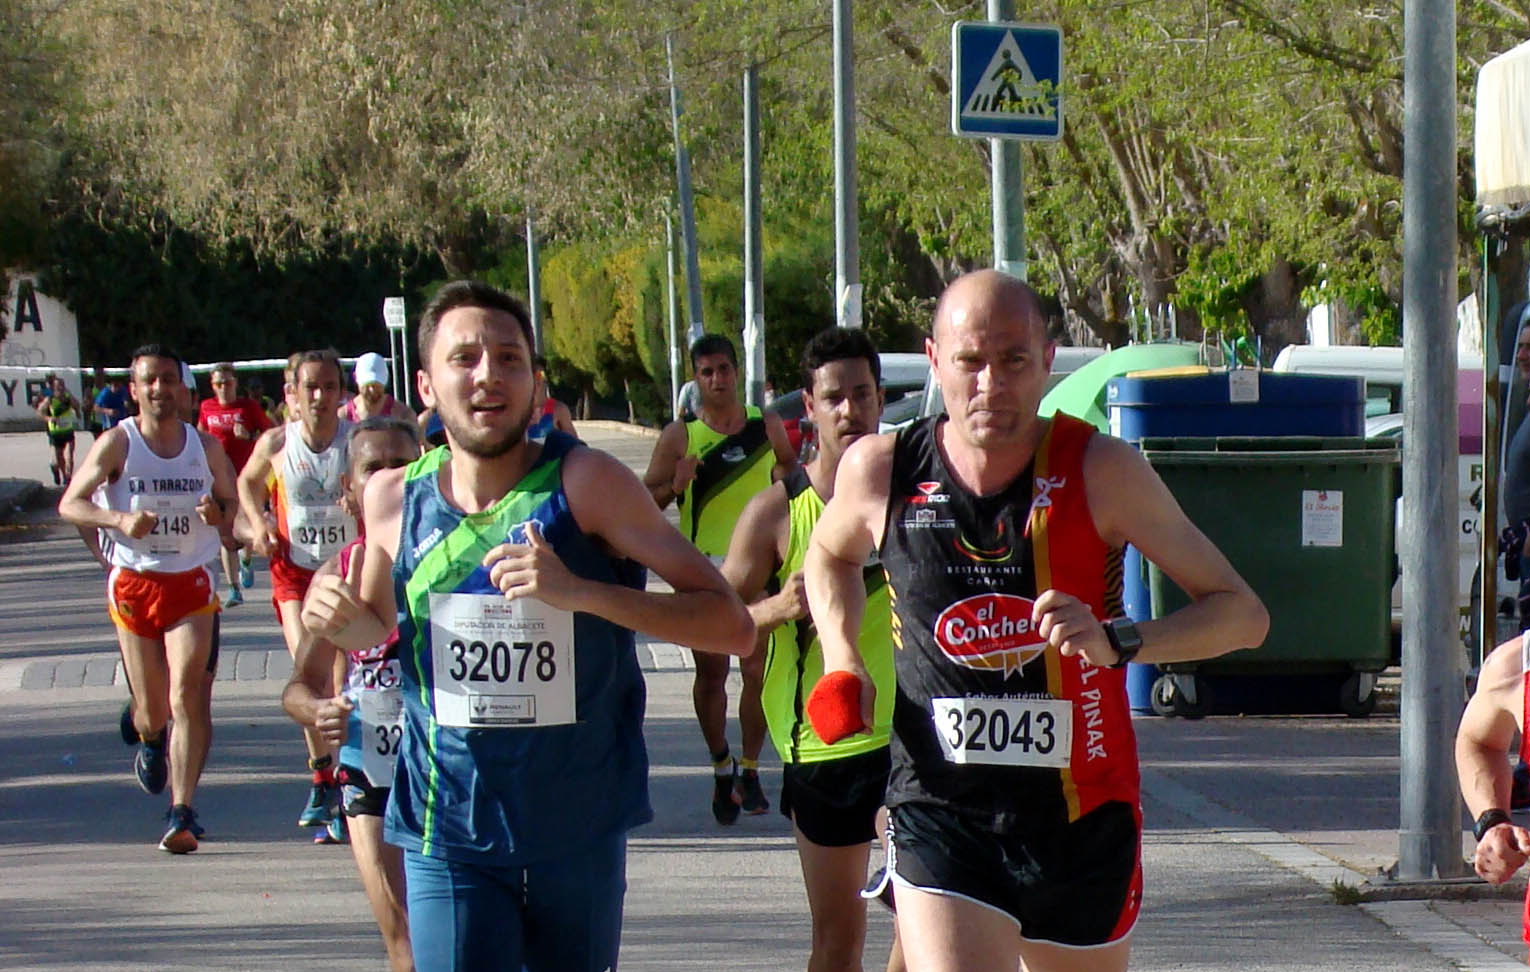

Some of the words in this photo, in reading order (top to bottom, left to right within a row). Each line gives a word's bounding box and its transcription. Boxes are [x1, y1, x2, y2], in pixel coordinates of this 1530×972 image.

[152, 478, 204, 493] TARAZON
[150, 515, 190, 535] 2148
[298, 525, 346, 545] 32151
[976, 602, 994, 621] el
[450, 640, 556, 683] 32078
[947, 707, 1055, 754] 32043
[1081, 688, 1108, 763] PINAR
[376, 724, 403, 756] 32
